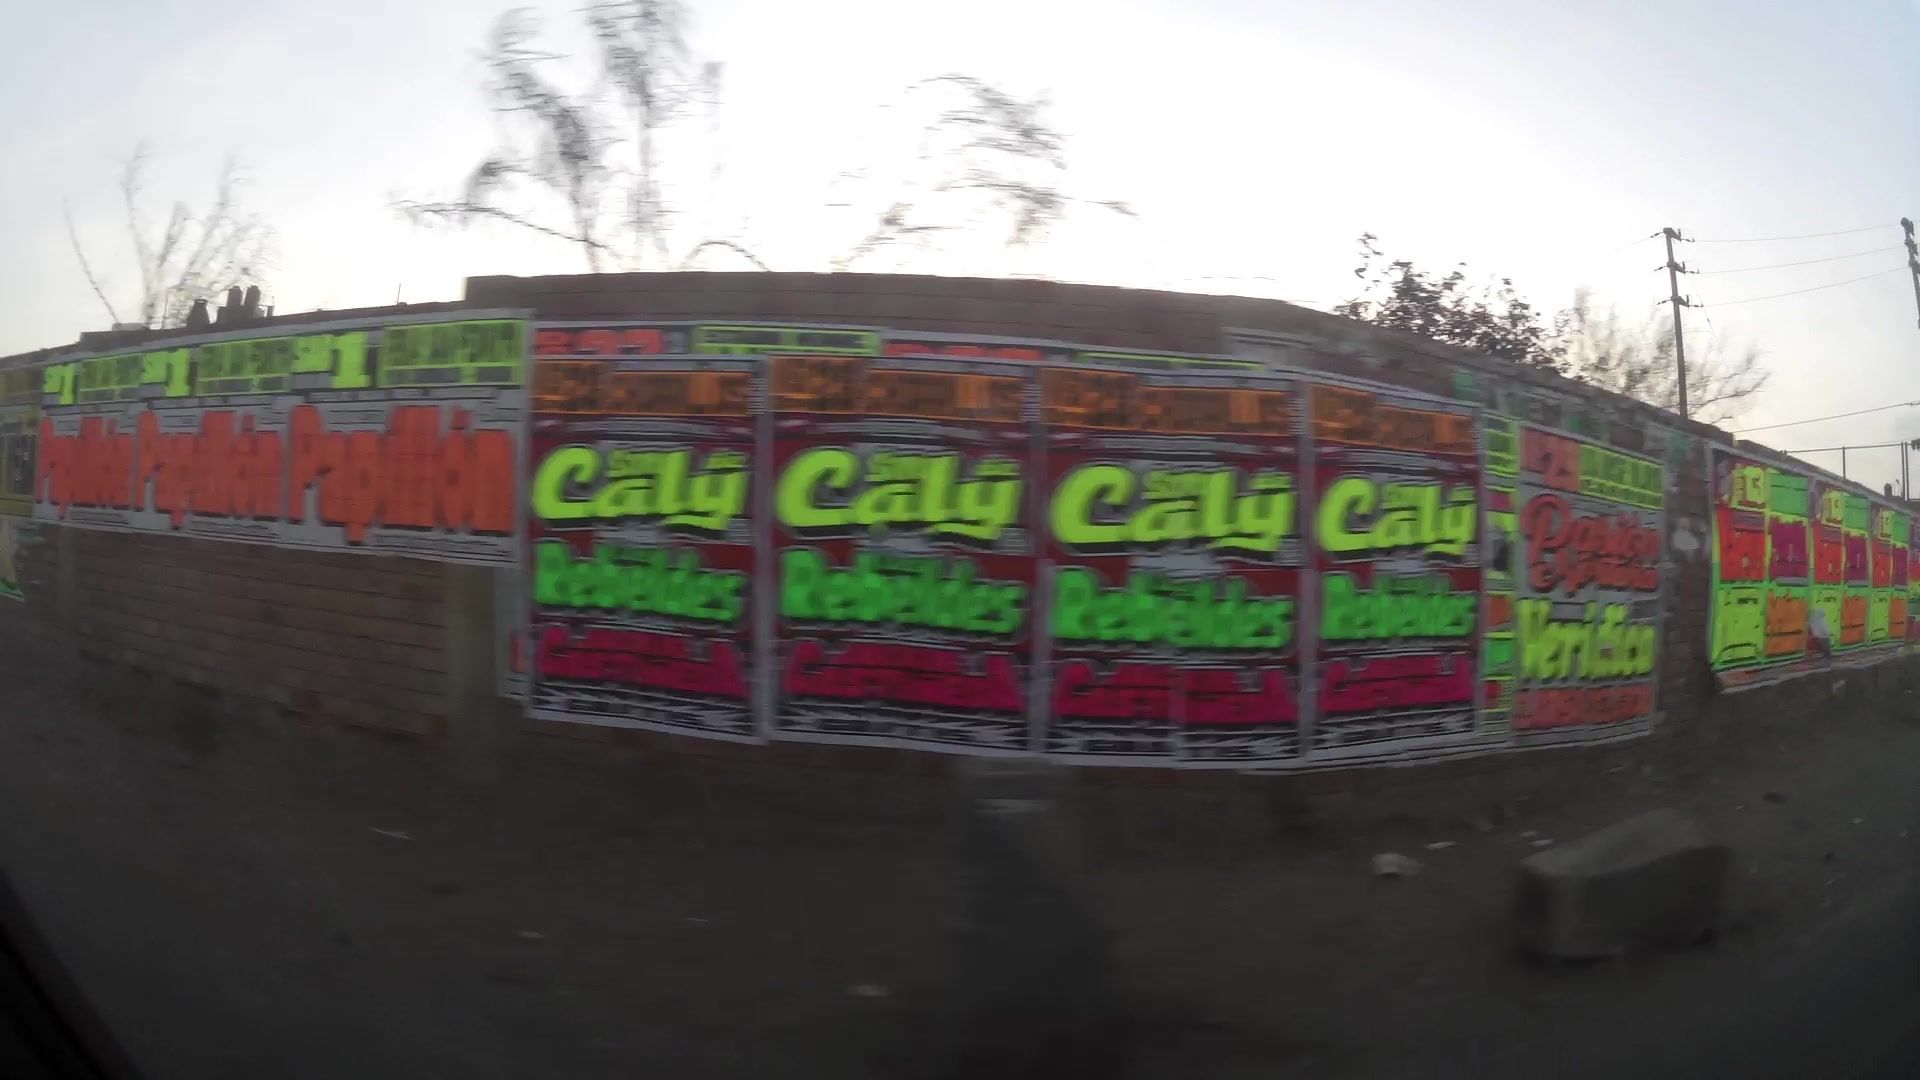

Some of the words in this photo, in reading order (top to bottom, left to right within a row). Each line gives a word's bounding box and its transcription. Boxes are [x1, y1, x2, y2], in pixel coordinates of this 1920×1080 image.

[532, 446, 746, 530] Caly
[776, 449, 1021, 541] Caly
[1050, 464, 1294, 553] Caly
[1317, 477, 1477, 556] Caly
